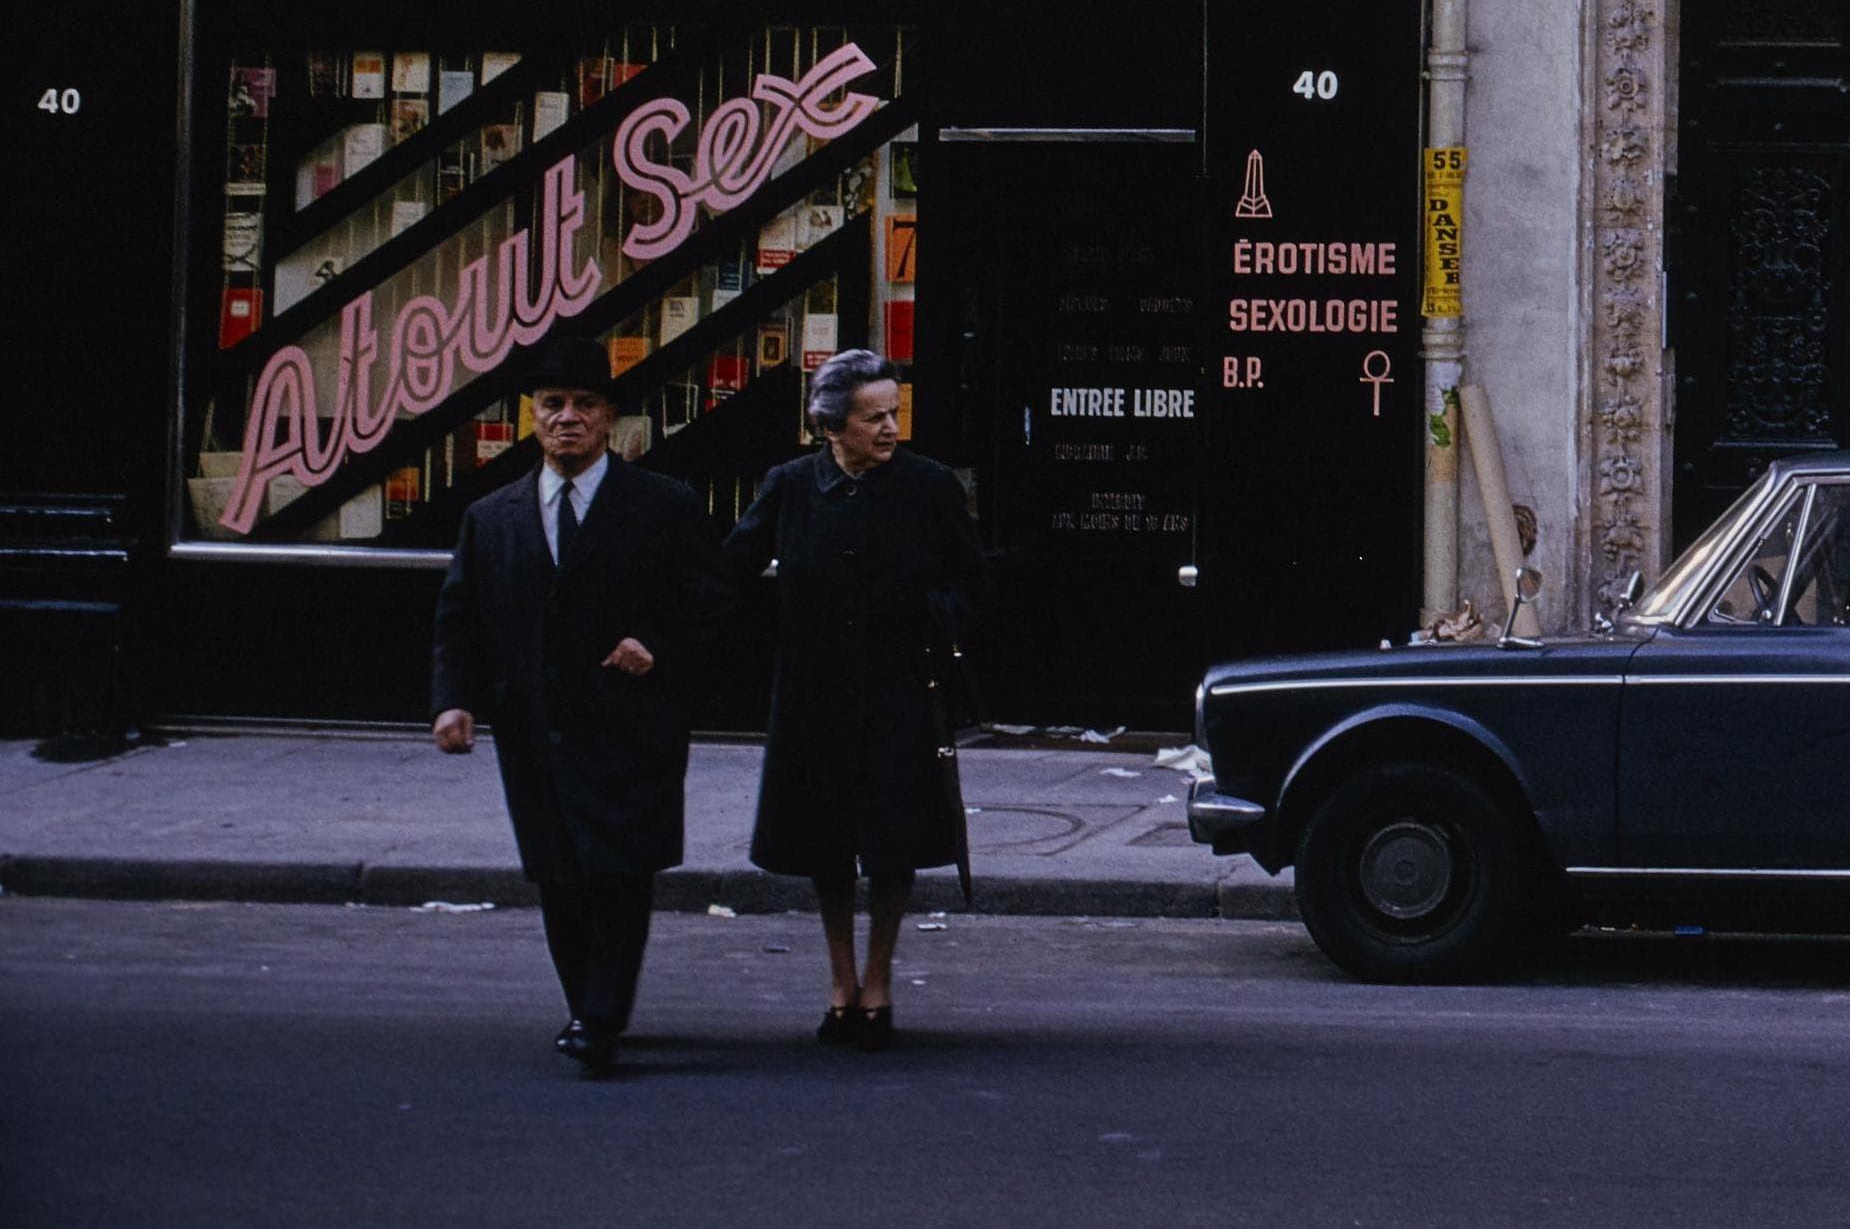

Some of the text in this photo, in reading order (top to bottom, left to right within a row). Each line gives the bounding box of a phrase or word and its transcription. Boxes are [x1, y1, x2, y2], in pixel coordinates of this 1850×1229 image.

[1292, 70, 1339, 100] 40
[37, 88, 81, 115] 40
[1433, 151, 1461, 170] 55
[1233, 238, 1397, 275] ÉROTISME
[220, 42, 878, 534] Atout Sex
[1229, 298, 1398, 333] SEXOLOGIE
[1223, 356, 1264, 389] B.P.
[1050, 387, 1195, 419] ENTREE LIBRE
